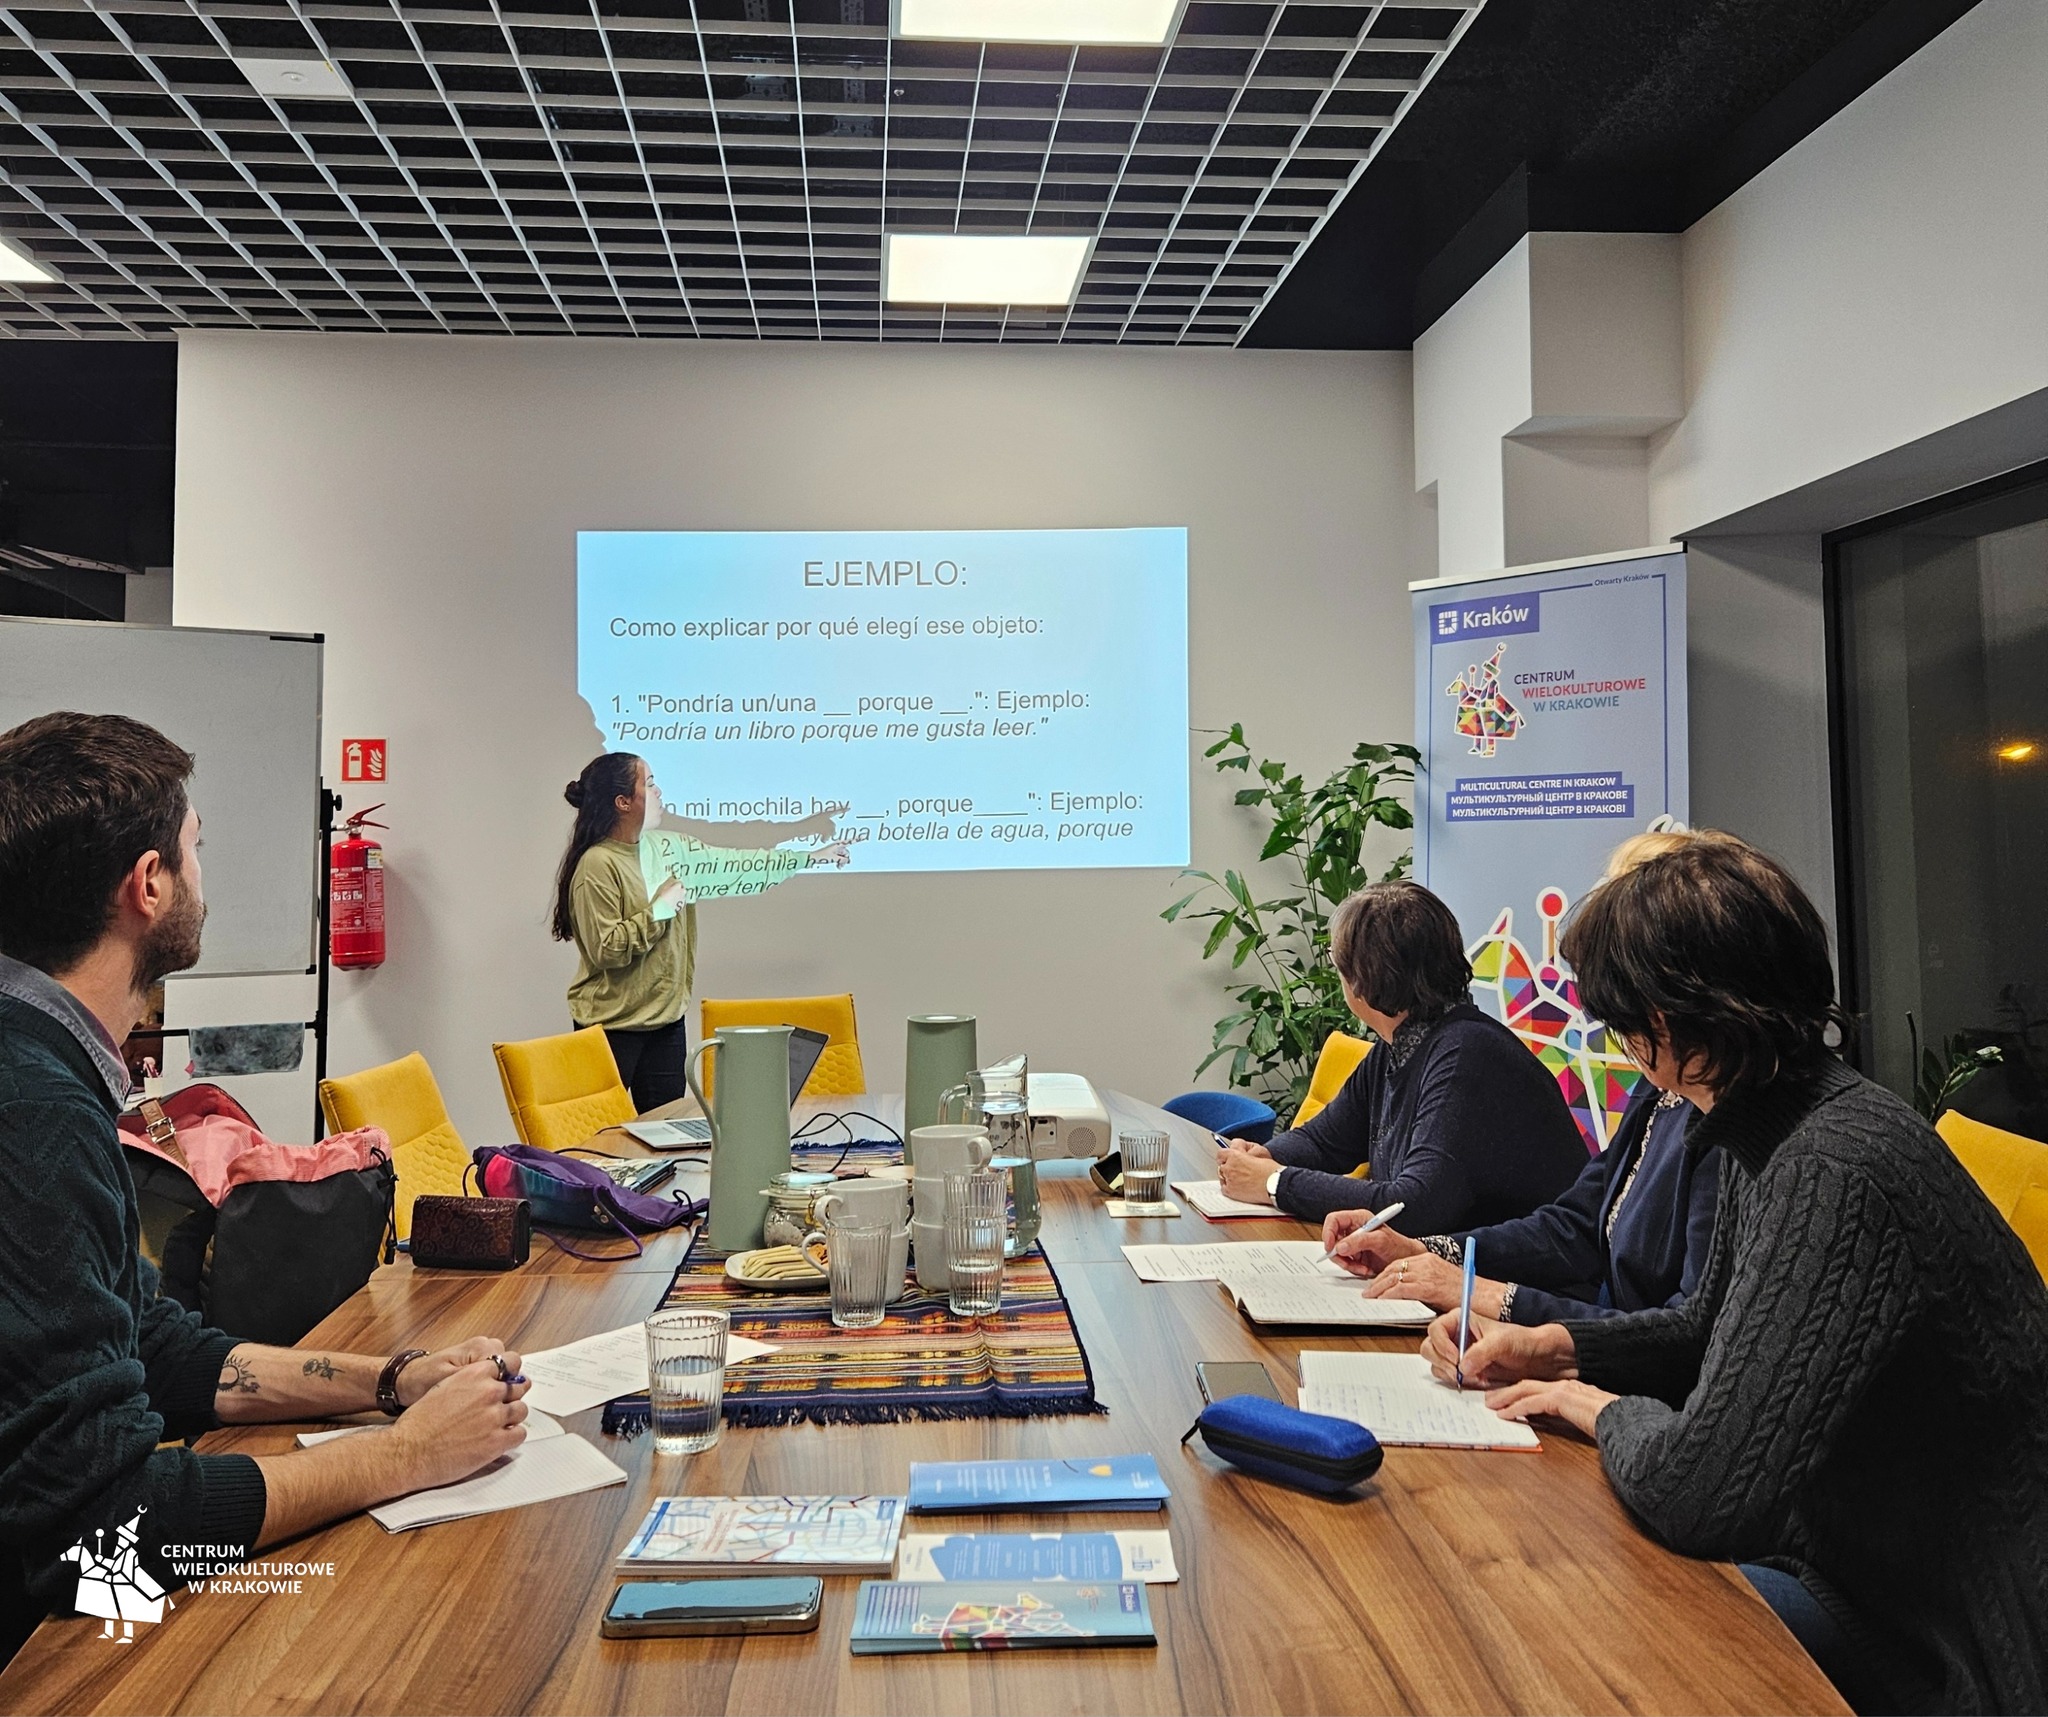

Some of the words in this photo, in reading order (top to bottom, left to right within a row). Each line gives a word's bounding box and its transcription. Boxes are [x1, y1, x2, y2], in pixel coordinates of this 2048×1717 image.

[804, 560, 967, 587] EJEMPLO:
[1594, 577, 1622, 587] Otwarty
[1623, 573, 1650, 583] Kraków
[1463, 604, 1530, 629] Kraków
[610, 617, 676, 637] Como
[683, 617, 770, 641] explicar
[776, 621, 812, 641] por
[818, 616, 859, 640] qué
[866, 616, 919, 640] elegí
[926, 620, 965, 635] ese
[972, 615, 1044, 639] objeto:
[1514, 669, 1575, 685] CENTRUM
[1522, 678, 1646, 699] WIELOKULTUROWE
[611, 694, 630, 714] 1.
[638, 693, 734, 713] "Pondría
[742, 693, 816, 713] un/una
[858, 696, 934, 716] porque
[997, 690, 1090, 714] Ejemplo:
[1533, 701, 1546, 712] W
[1549, 696, 1620, 711] KRAKOWIE
[612, 721, 707, 741] "Pondría
[714, 725, 742, 740] un
[749, 720, 795, 740] libro
[801, 723, 879, 744] porque
[885, 723, 919, 738] me
[926, 719, 985, 742] gusta
[992, 717, 1049, 737] leer."
[1460, 781, 1528, 792] MULTICULTURAL
[1528, 779, 1562, 790] CENTRE
[1563, 778, 1573, 788] IN
[1574, 777, 1616, 788] KRAKOW
[685, 797, 710, 816] mi
[719, 796, 803, 816] mochila
[1051, 791, 1143, 815] Ejemplo:
[1451, 792, 1544, 805] МУЛЬТИКУЛЬТУРНЫЙ
[1545, 791, 1574, 803] ЦЕНТР
[1575, 791, 1582, 801] В
[1583, 790, 1628, 801] КРАКОВЕ
[1452, 805, 1544, 818] МУЛЬТИКУЛЬТУРНИЙ
[1545, 805, 1575, 817] ЦЕНТР
[1576, 804, 1582, 814] В
[1583, 803, 1626, 814] КРАКОВІ
[877, 821, 949, 841] botella
[957, 820, 984, 840] de
[990, 823, 1049, 843] agua,
[1057, 822, 1134, 842] porque
[694, 857, 719, 875] mi
[723, 853, 798, 873] mochila
